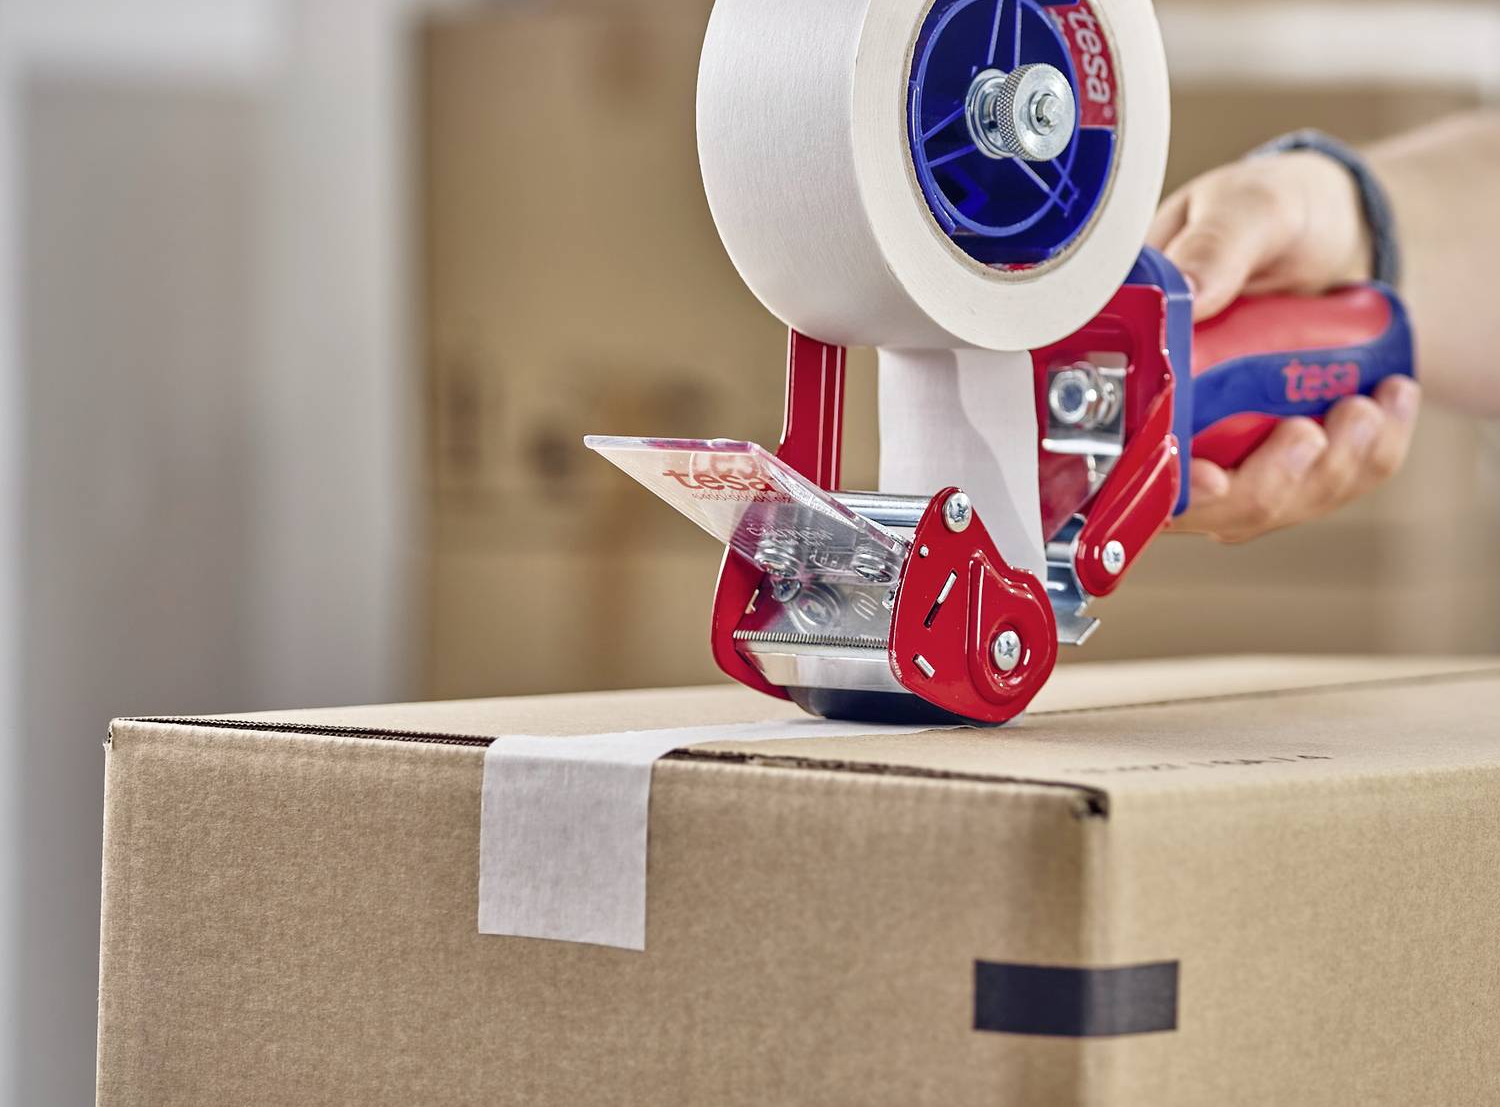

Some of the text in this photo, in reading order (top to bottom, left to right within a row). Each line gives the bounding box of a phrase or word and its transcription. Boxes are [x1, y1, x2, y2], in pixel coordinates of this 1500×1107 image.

[1067, 6, 1113, 105] tesa
[1283, 359, 1359, 401] tesa
[662, 469, 775, 491] tesa
